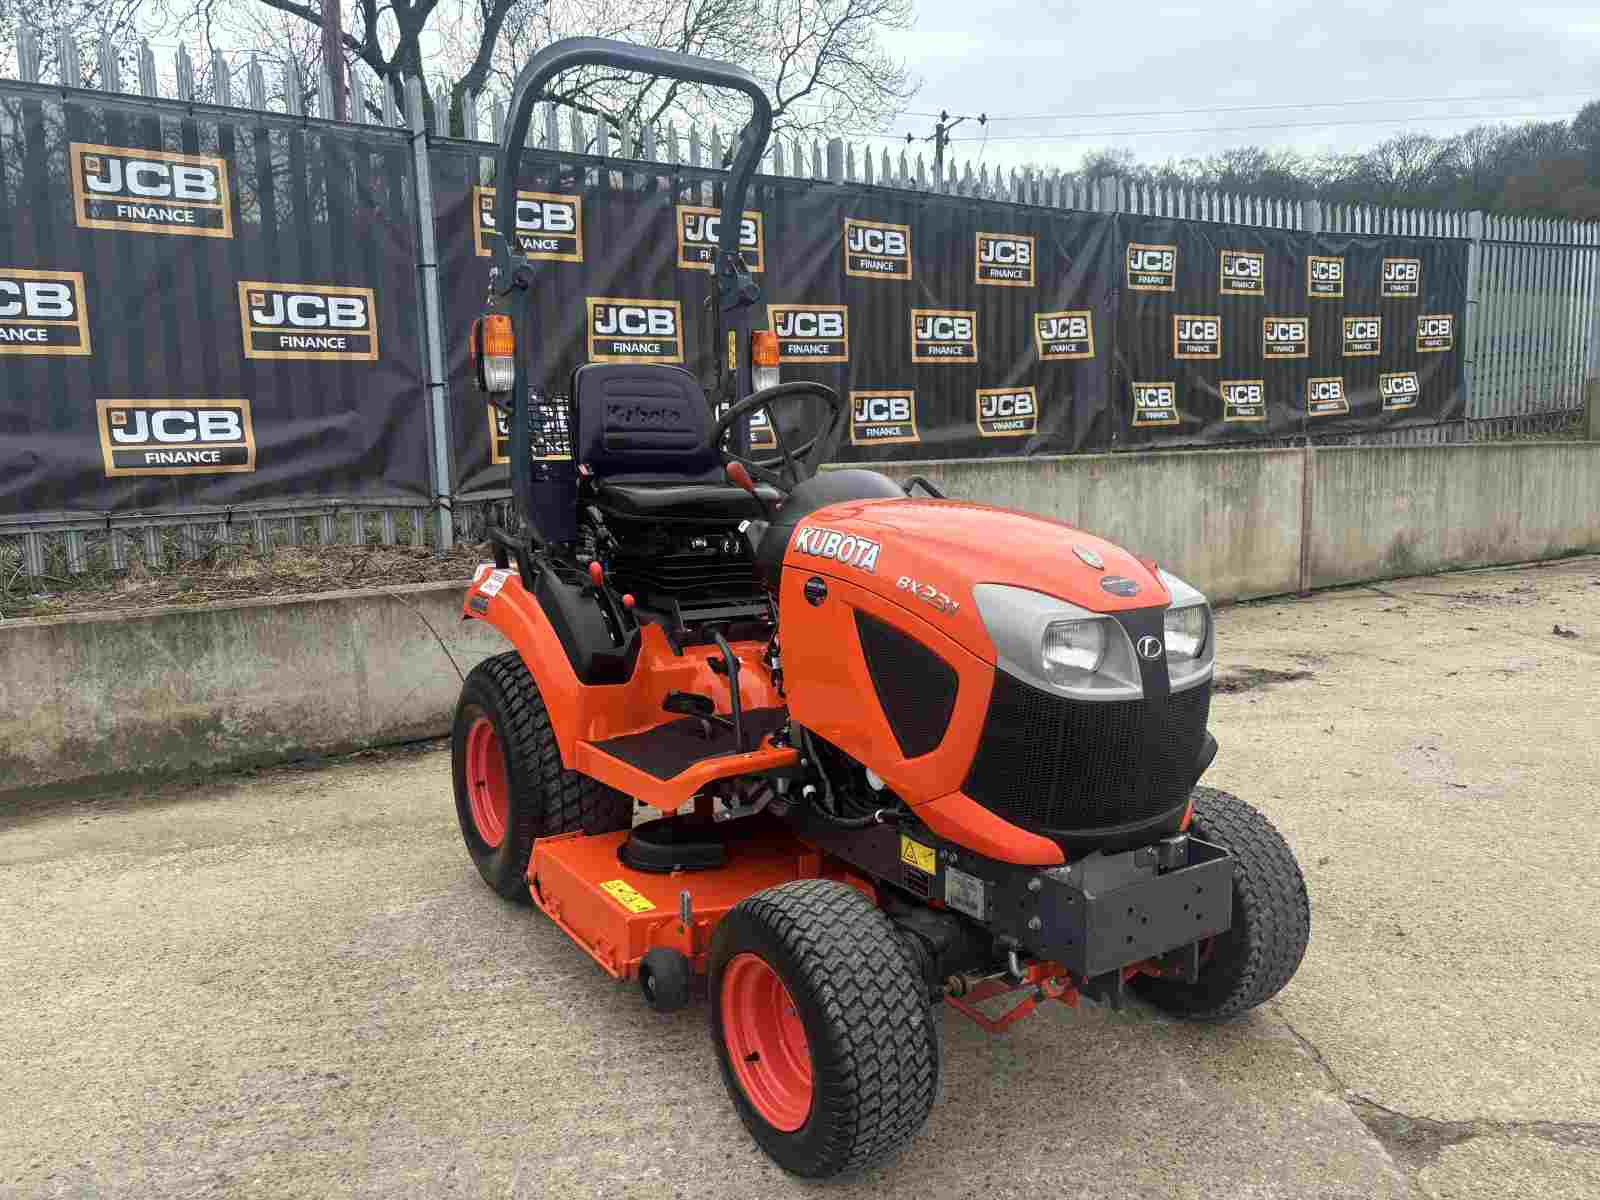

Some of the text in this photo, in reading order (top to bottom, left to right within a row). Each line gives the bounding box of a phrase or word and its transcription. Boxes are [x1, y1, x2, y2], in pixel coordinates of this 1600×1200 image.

[85, 158, 218, 201] JCB
[116, 205, 196, 224] FINANCE
[519, 238, 559, 251] NANCE
[850, 228, 905, 255] JCB
[981, 240, 1030, 265] JCB
[1130, 251, 1173, 271] JCB
[860, 259, 894, 272] FINANCE
[1225, 257, 1261, 276] JCB
[1384, 264, 1417, 281] JCB
[251, 292, 367, 328] JCB
[594, 307, 676, 335] JCB
[776, 312, 843, 337] JCB
[917, 317, 972, 340] JCB
[1040, 318, 1087, 340] JCB
[1346, 322, 1378, 339] JCB
[1419, 320, 1450, 336] JCB
[1179, 321, 1217, 341] JCB
[1266, 323, 1304, 340] JCB
[279, 336, 347, 349] FINANCE
[613, 343, 661, 353] FINANCE
[788, 344, 830, 354] FINANCE
[1226, 386, 1261, 404] JCB
[1384, 378, 1417, 394] JCB
[982, 393, 1033, 416] JCB
[1136, 389, 1172, 407] JCB
[855, 399, 910, 422] JCB
[111, 410, 242, 442] JCB
[144, 449, 221, 464] FINANCE
[795, 526, 880, 573] KUBOTA
